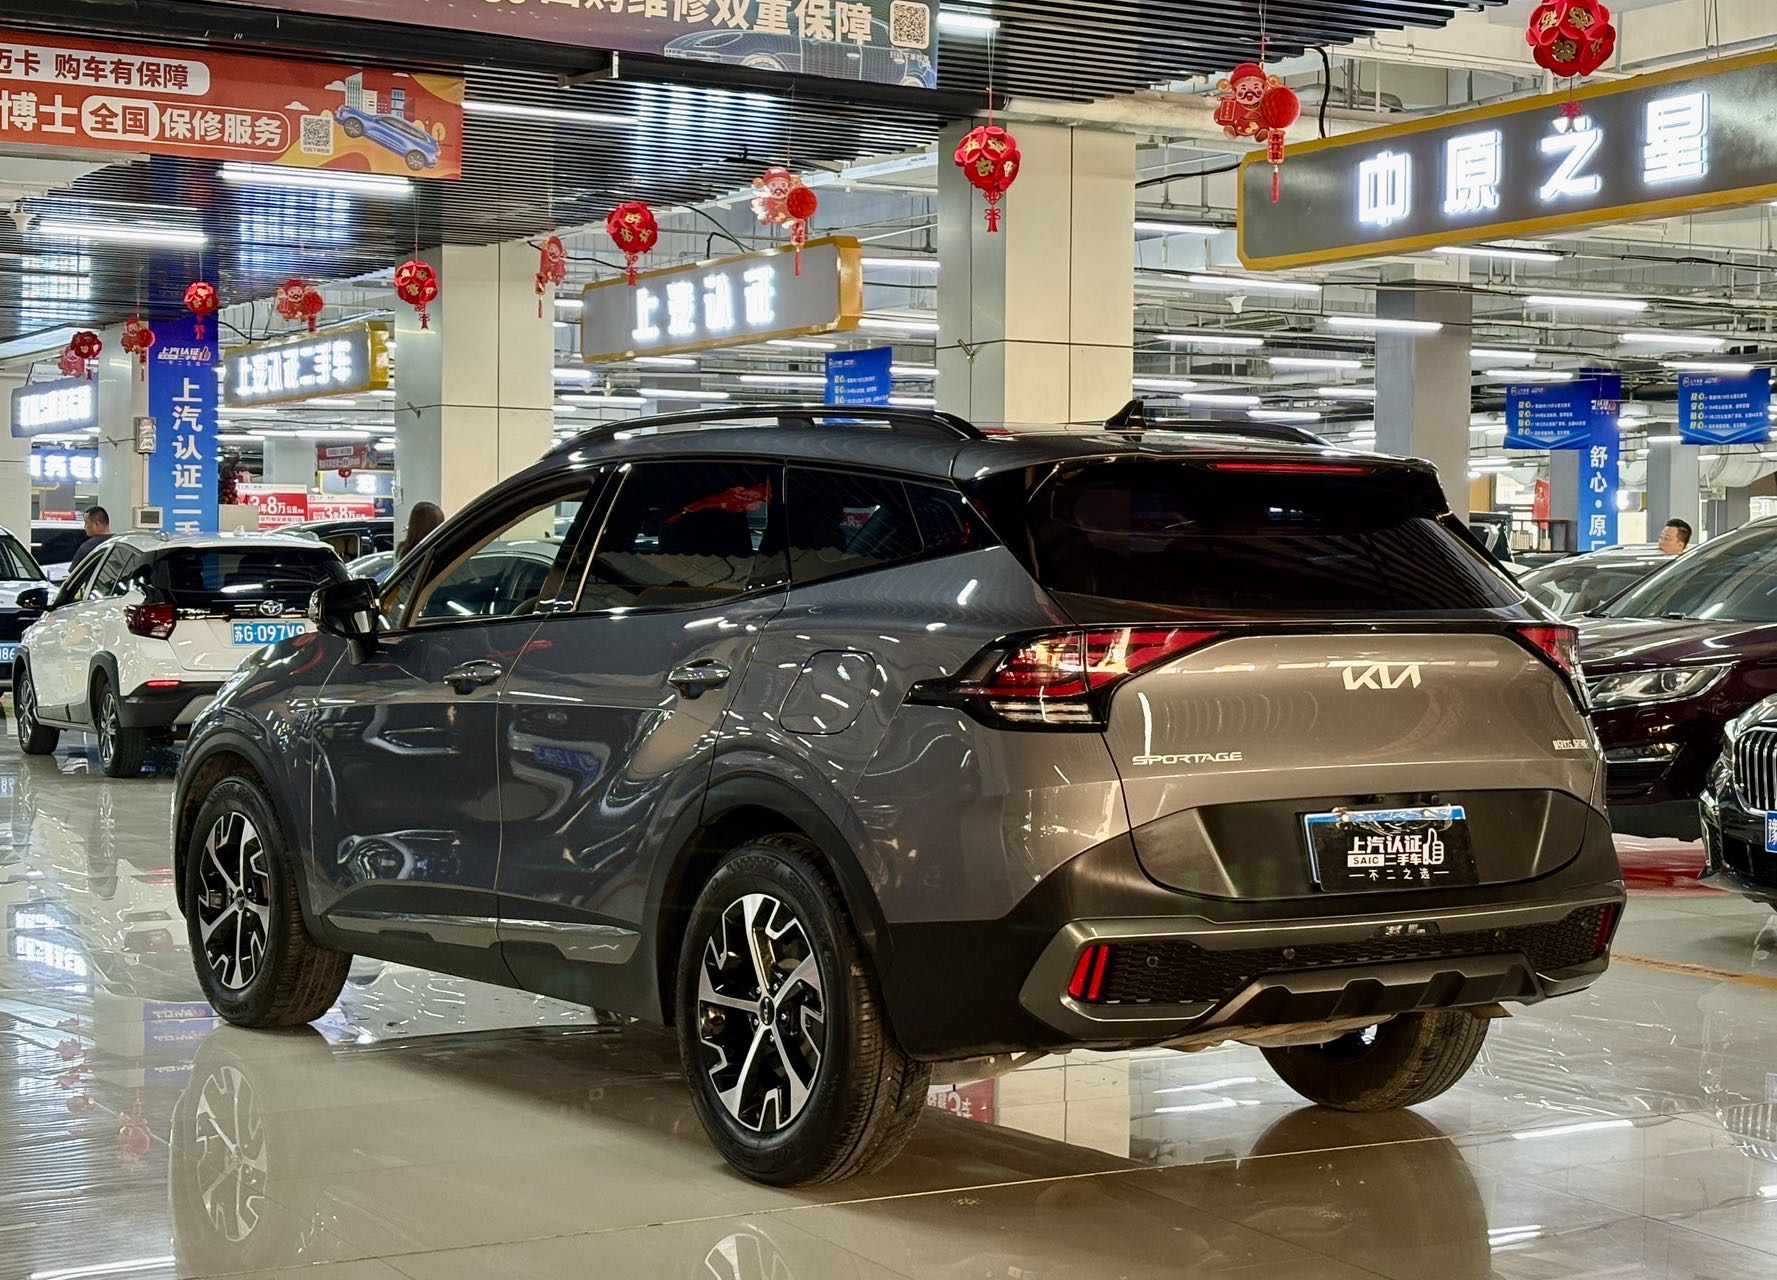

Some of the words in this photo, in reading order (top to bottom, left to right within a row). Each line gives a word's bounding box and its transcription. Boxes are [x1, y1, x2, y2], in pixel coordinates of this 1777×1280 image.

[54, 53, 189, 90] 购车有保障
[1356, 91, 1712, 227] 中原之星
[1342, 664, 1422, 690] KIA
[1132, 751, 1243, 766] SPORTAGE
[1347, 835, 1423, 854] 上汽认证
[1353, 856, 1381, 865] SAIC
[1385, 853, 1422, 865] 二手车
[1368, 867, 1432, 881] 不二之选
